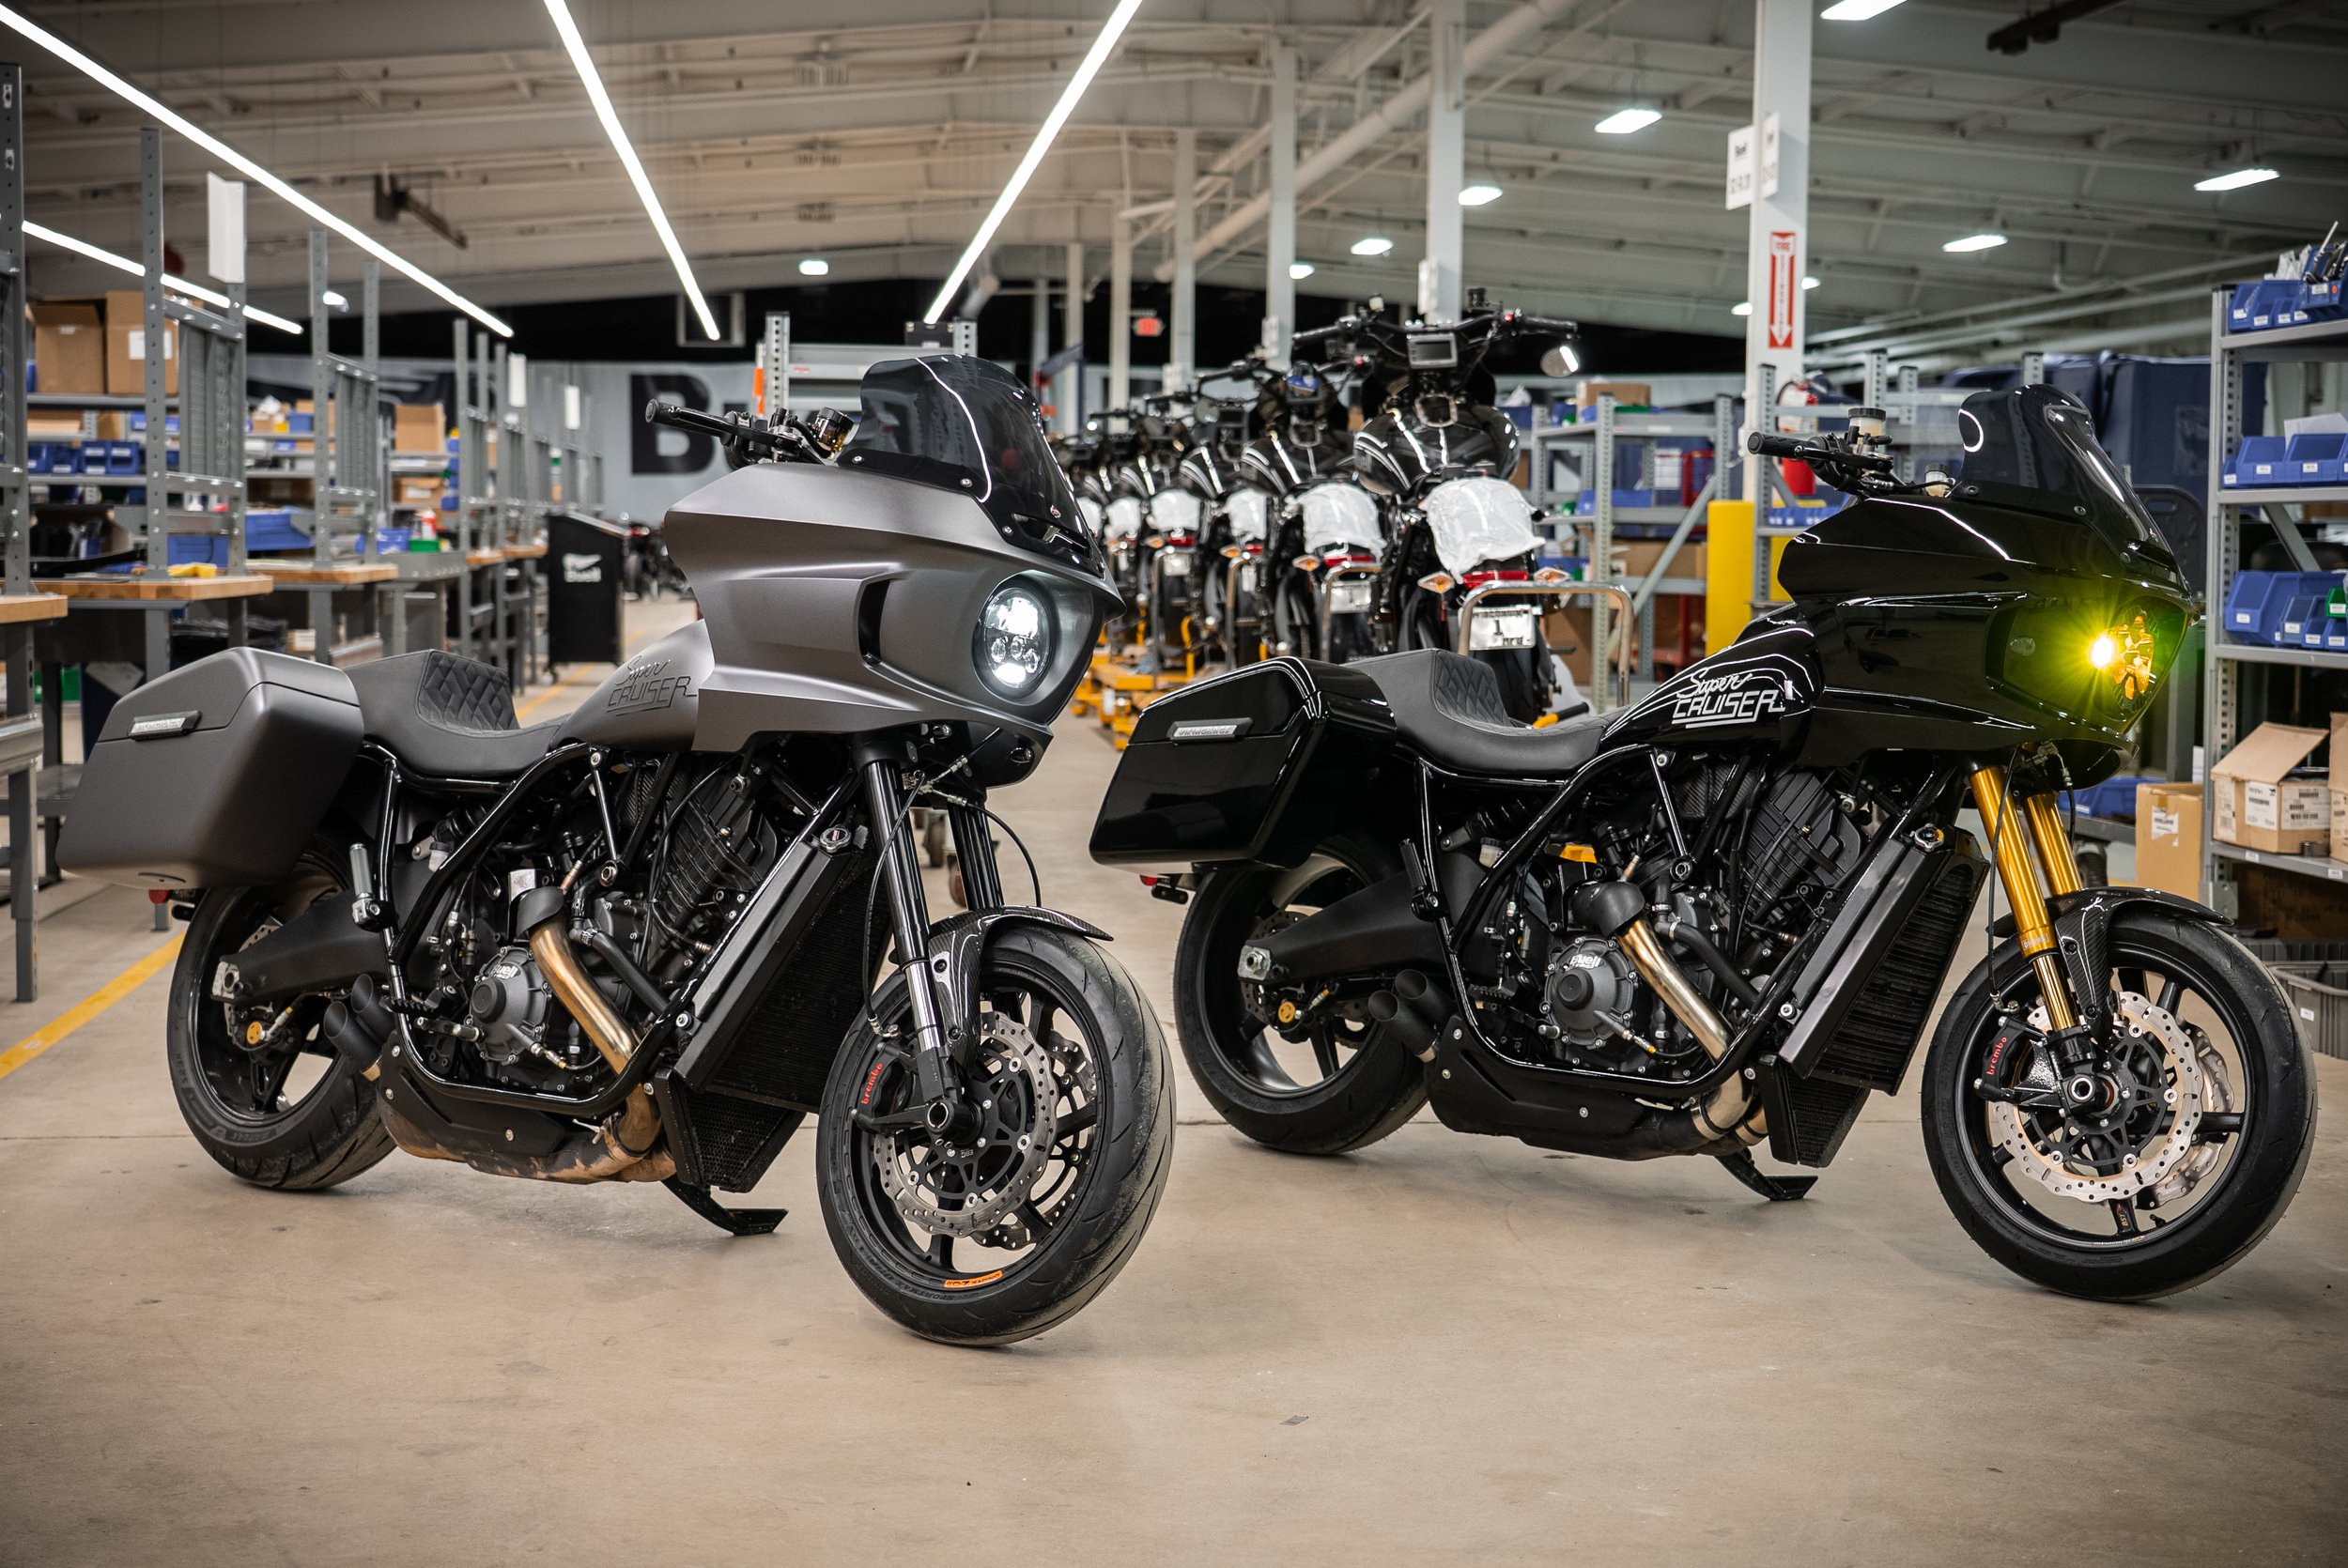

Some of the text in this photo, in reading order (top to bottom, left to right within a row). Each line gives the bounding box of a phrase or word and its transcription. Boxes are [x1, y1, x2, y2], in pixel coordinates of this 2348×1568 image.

[613, 655, 671, 687] Super
[1676, 667, 1753, 699] Super
[607, 675, 697, 714] CRUISER
[1672, 689, 1785, 727] CRUISER
[1569, 954, 1602, 968] Buell
[1985, 1037, 2008, 1076] brembo
[860, 1062, 883, 1104] brembo
